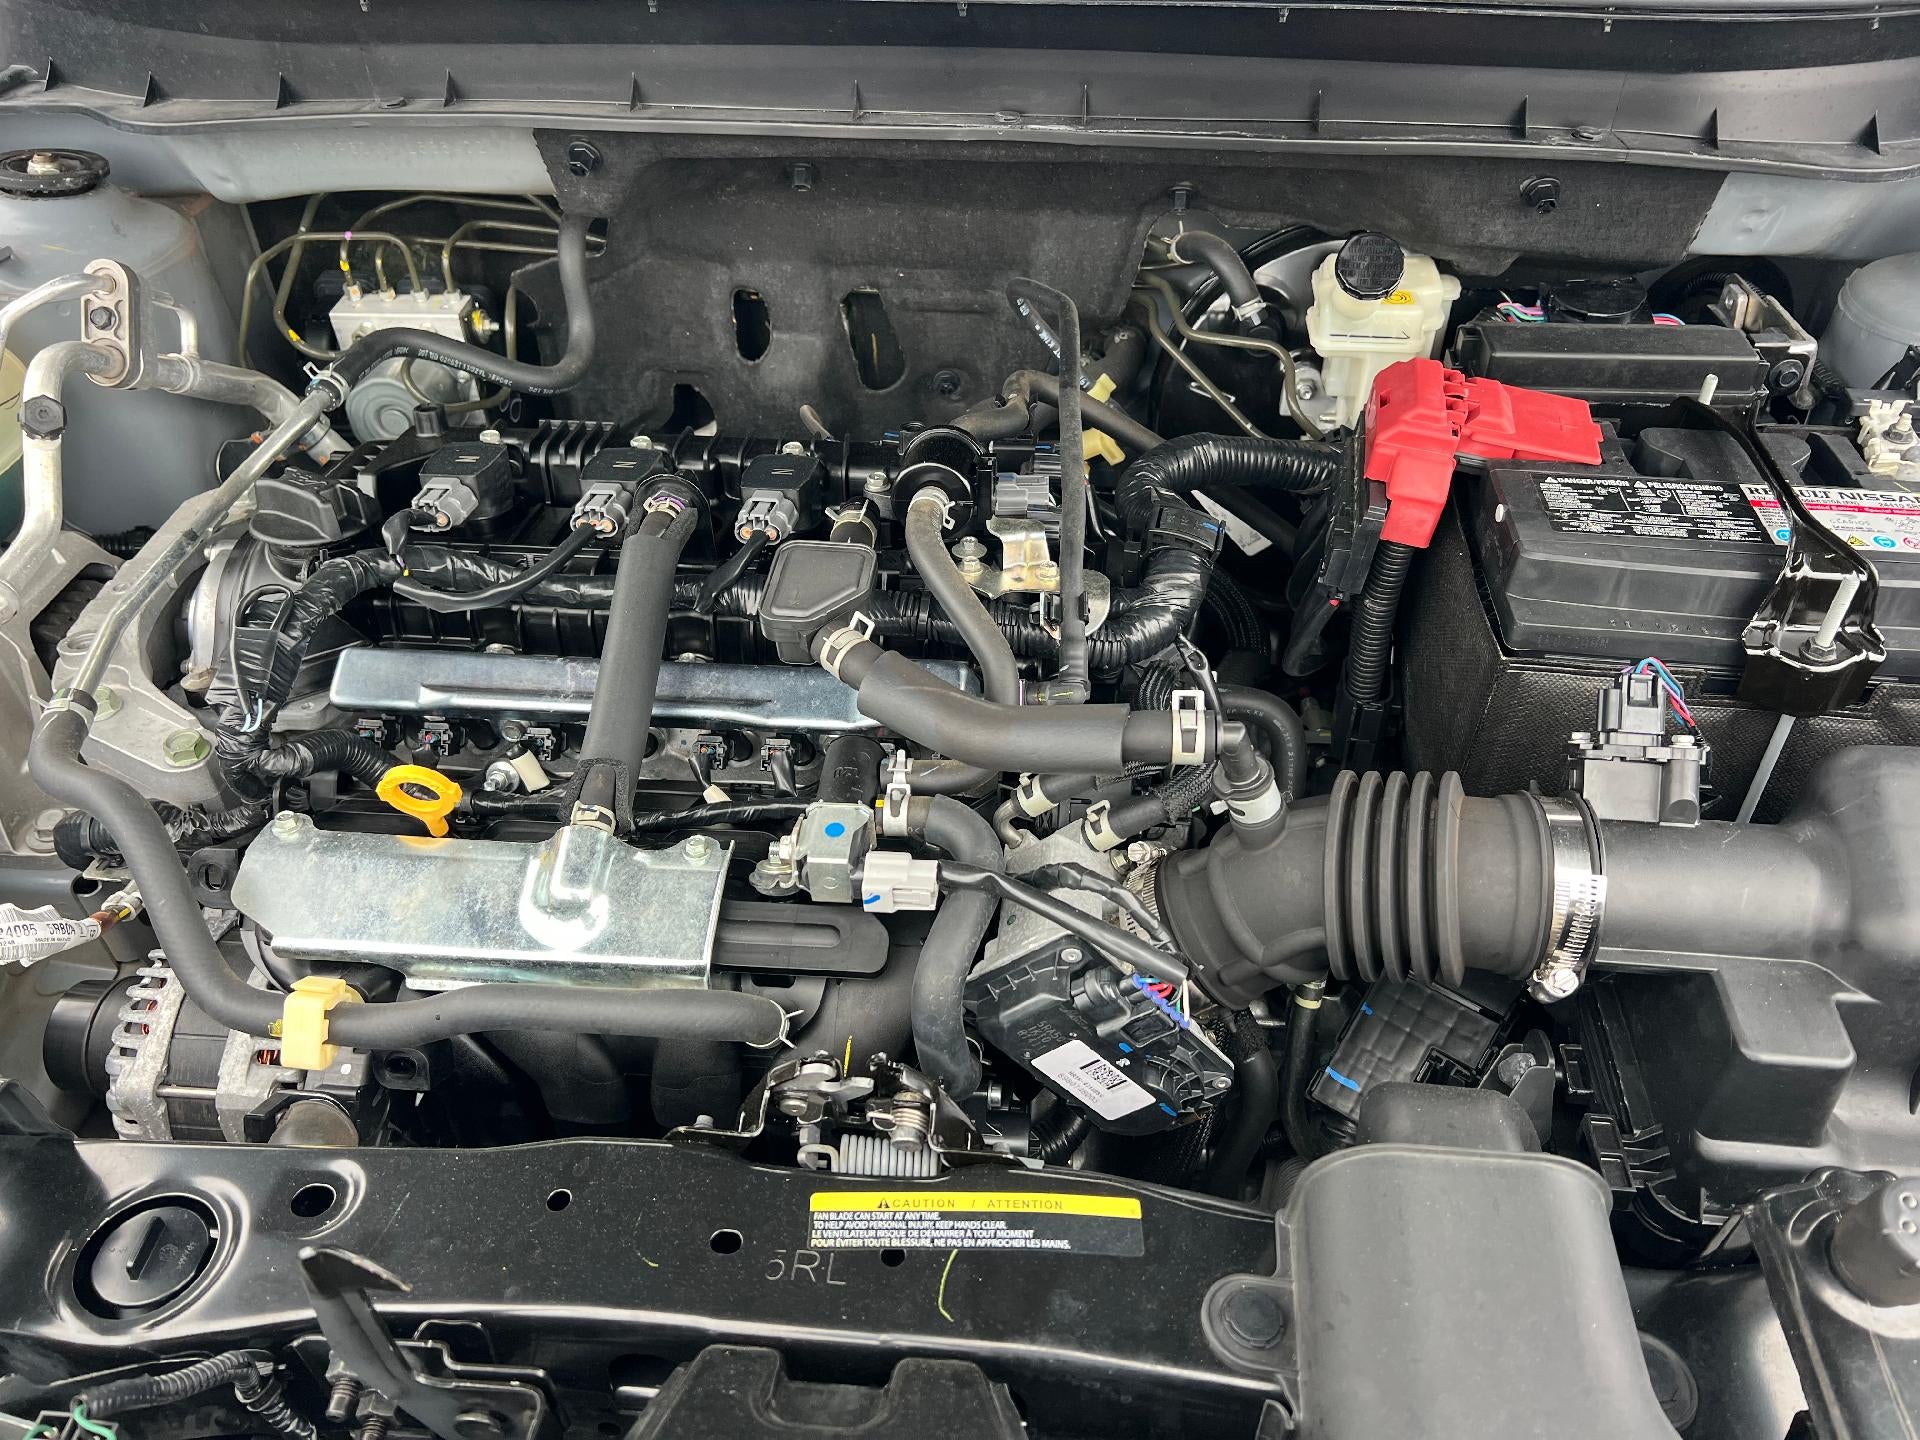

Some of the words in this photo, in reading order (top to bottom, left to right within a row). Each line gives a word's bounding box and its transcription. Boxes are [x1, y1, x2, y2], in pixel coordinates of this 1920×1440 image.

[1556, 477, 1630, 487] DANGER/POISON
[892, 1199, 955, 1208] CAUTION
[986, 1199, 1063, 1210] ATTENTION
[813, 1212, 829, 1220] FAN
[829, 1212, 853, 1220] BLADE
[854, 1212, 870, 1220] CAN
[871, 1212, 894, 1220] START
[894, 1212, 905, 1220] AT
[813, 1221, 824, 1229] TO
[825, 1221, 844, 1229] HELP
[844, 1221, 868, 1229] AVOID
[869, 1221, 907, 1229] PERSONAL
[936, 1221, 953, 1229] KEEP
[954, 1221, 980, 1229] HANDS
[981, 1221, 1007, 1229] CLEAR.
[812, 1229, 822, 1238] LE
[822, 1229, 876, 1238] VENTILATEUR
[877, 1229, 906, 1238] RISQUE
[908, 1229, 919, 1238] DE
[973, 1229, 995, 1238] TOUT
[995, 1229, 1034, 1238] MOMENT
[811, 1238, 835, 1247] POUR
[864, 1238, 890, 1247] TOUTE
[891, 1238, 933, 1247] BLESSURE,
[934, 1238, 946, 1247] NE
[947, 1238, 962, 1247] PAS
[963, 1238, 975, 1247] EN
[976, 1238, 1025, 1247] APPROCHER
[1026, 1238, 1041, 1247] LES
[1041, 1239, 1072, 1249] MAINS.
